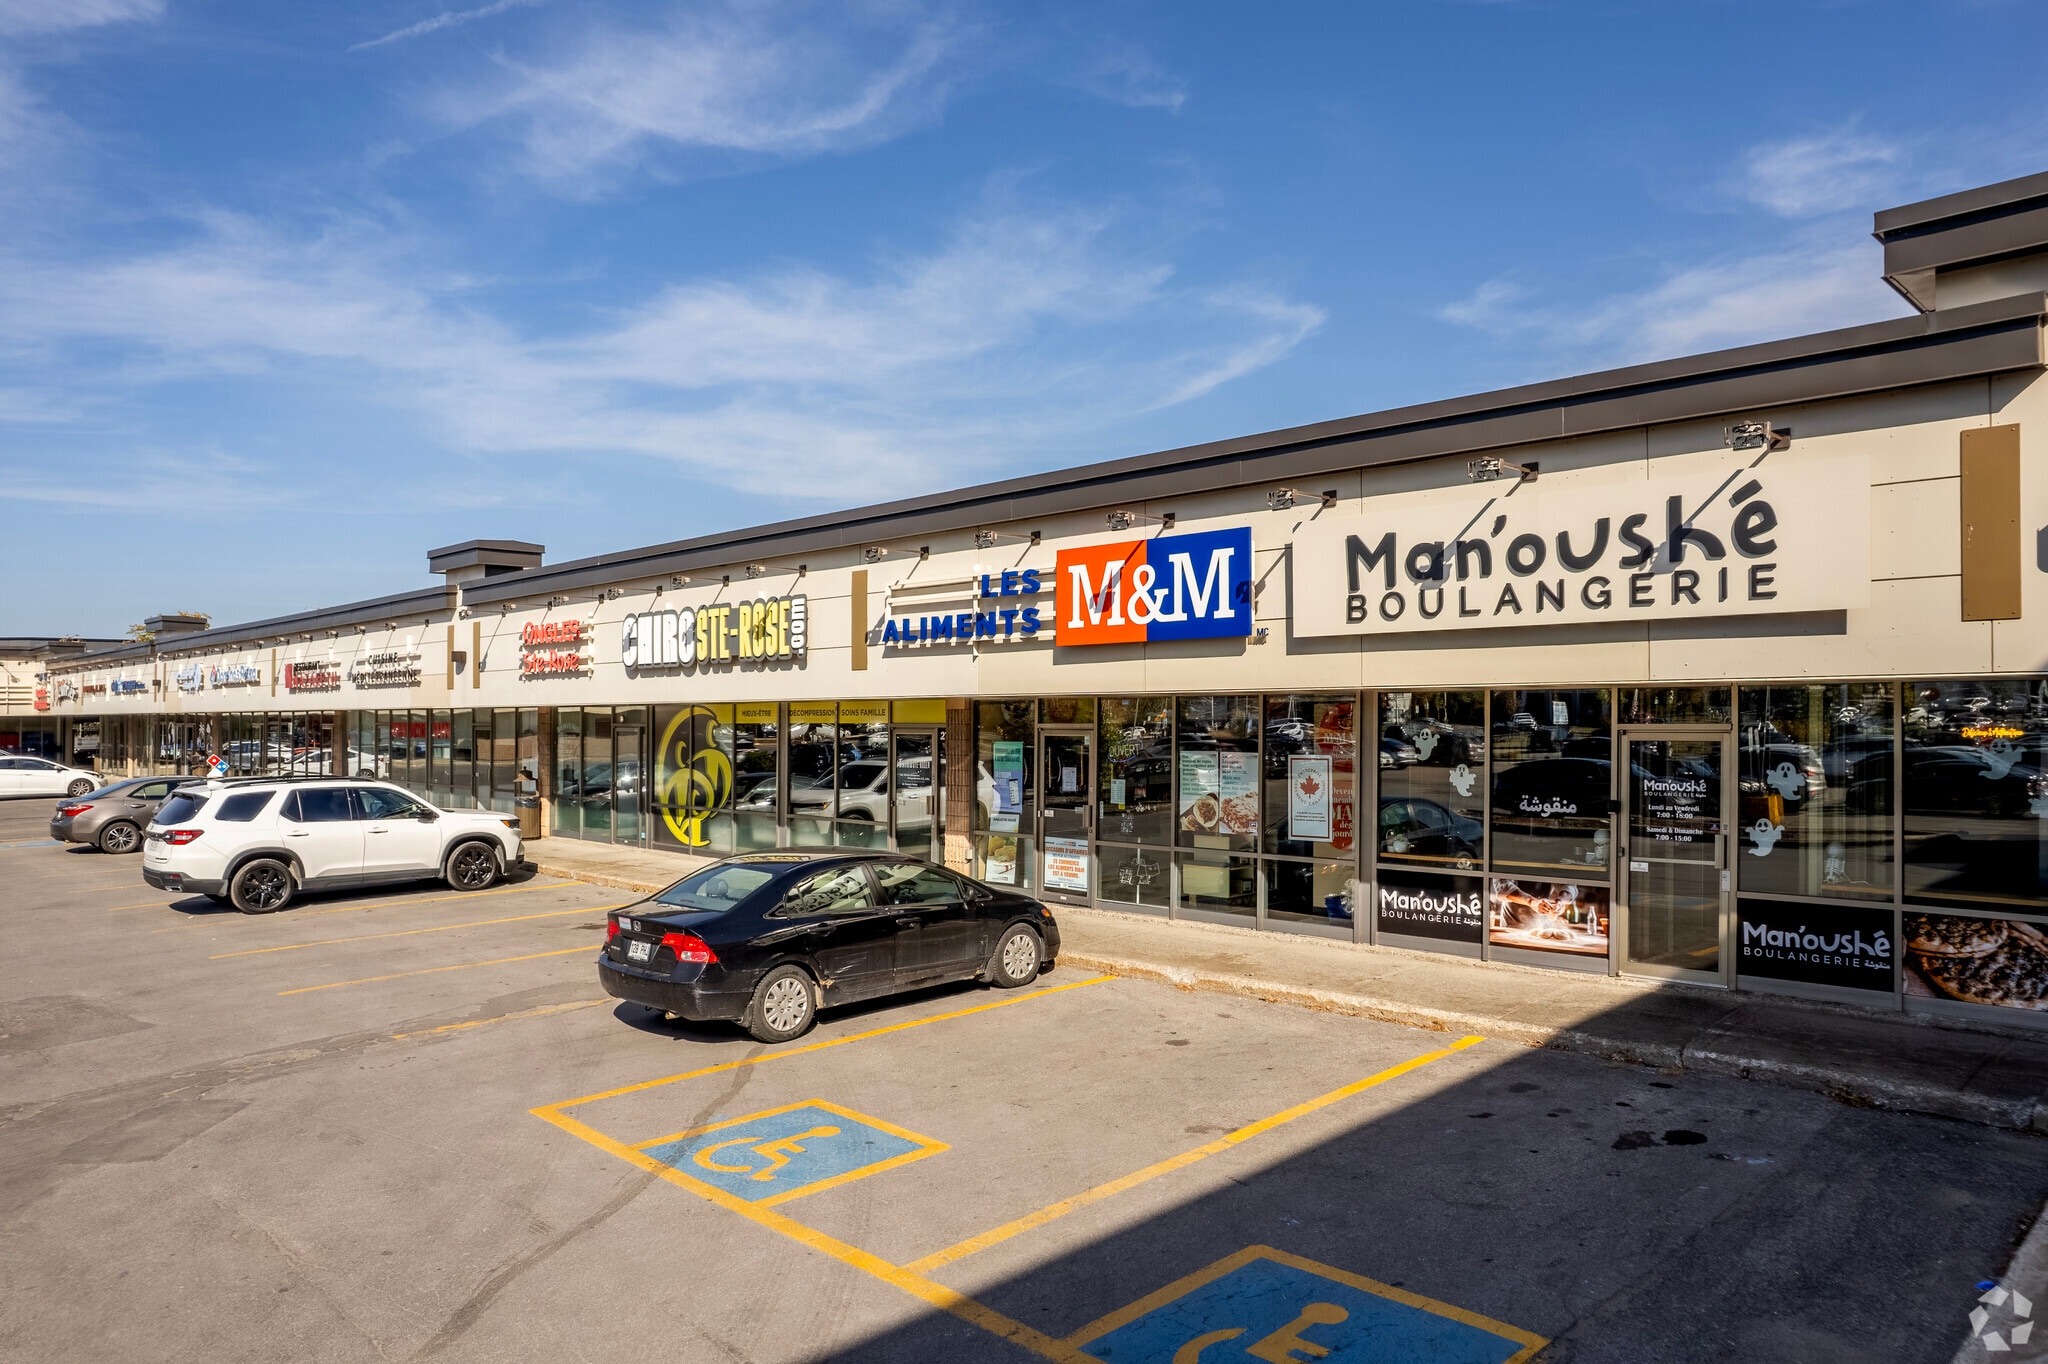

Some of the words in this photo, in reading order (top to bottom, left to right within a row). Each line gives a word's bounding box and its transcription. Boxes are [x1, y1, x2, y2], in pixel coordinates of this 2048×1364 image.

[1345, 479, 1778, 594] Man'oushé
[981, 568, 1041, 598] LES
[1068, 546, 1235, 629] M&M
[1345, 562, 1778, 625] BOULANGERIE
[524, 620, 580, 645] ONGLES
[882, 607, 1041, 643] ALIMENTS
[1256, 627, 1269, 637] MC
[368, 652, 398, 665] CUISINE
[524, 649, 580, 672] Ste-Rose
[742, 709, 771, 717] MIEUX-ÊTRE
[861, 708, 886, 716] FAMILLE
[1109, 743, 1140, 757] OUVERT
[1644, 779, 1707, 792] Man'oushé
[1519, 794, 1577, 817] منقوشة
[1381, 888, 1482, 916] Man'oushé
[1381, 909, 1462, 925] BOULANGERIE
[1743, 921, 1891, 958] Man'oushé
[1743, 947, 1861, 968] BOULANGERIE
